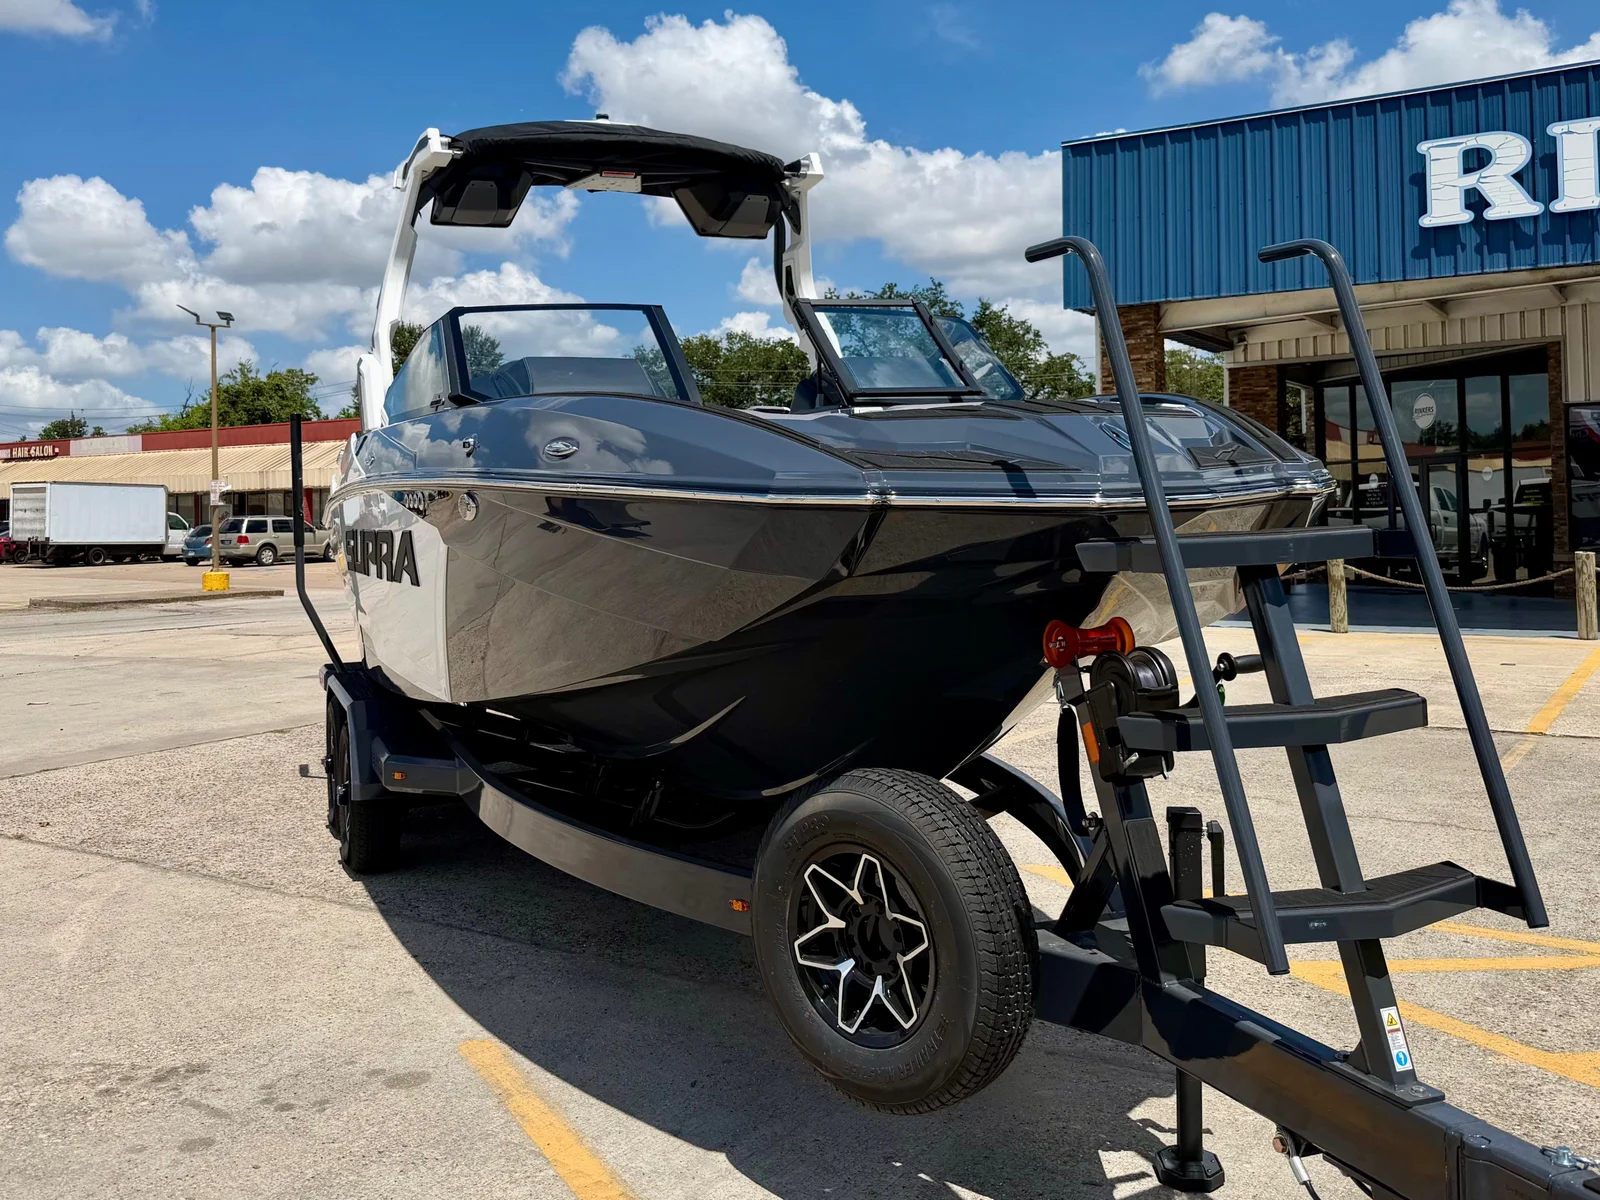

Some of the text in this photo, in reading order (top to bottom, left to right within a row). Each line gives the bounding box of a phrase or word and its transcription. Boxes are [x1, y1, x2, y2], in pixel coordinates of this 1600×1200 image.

[12, 447, 29, 459] HAIR
[30, 445, 53, 457] SALON
[346, 529, 420, 587] SUPRA
